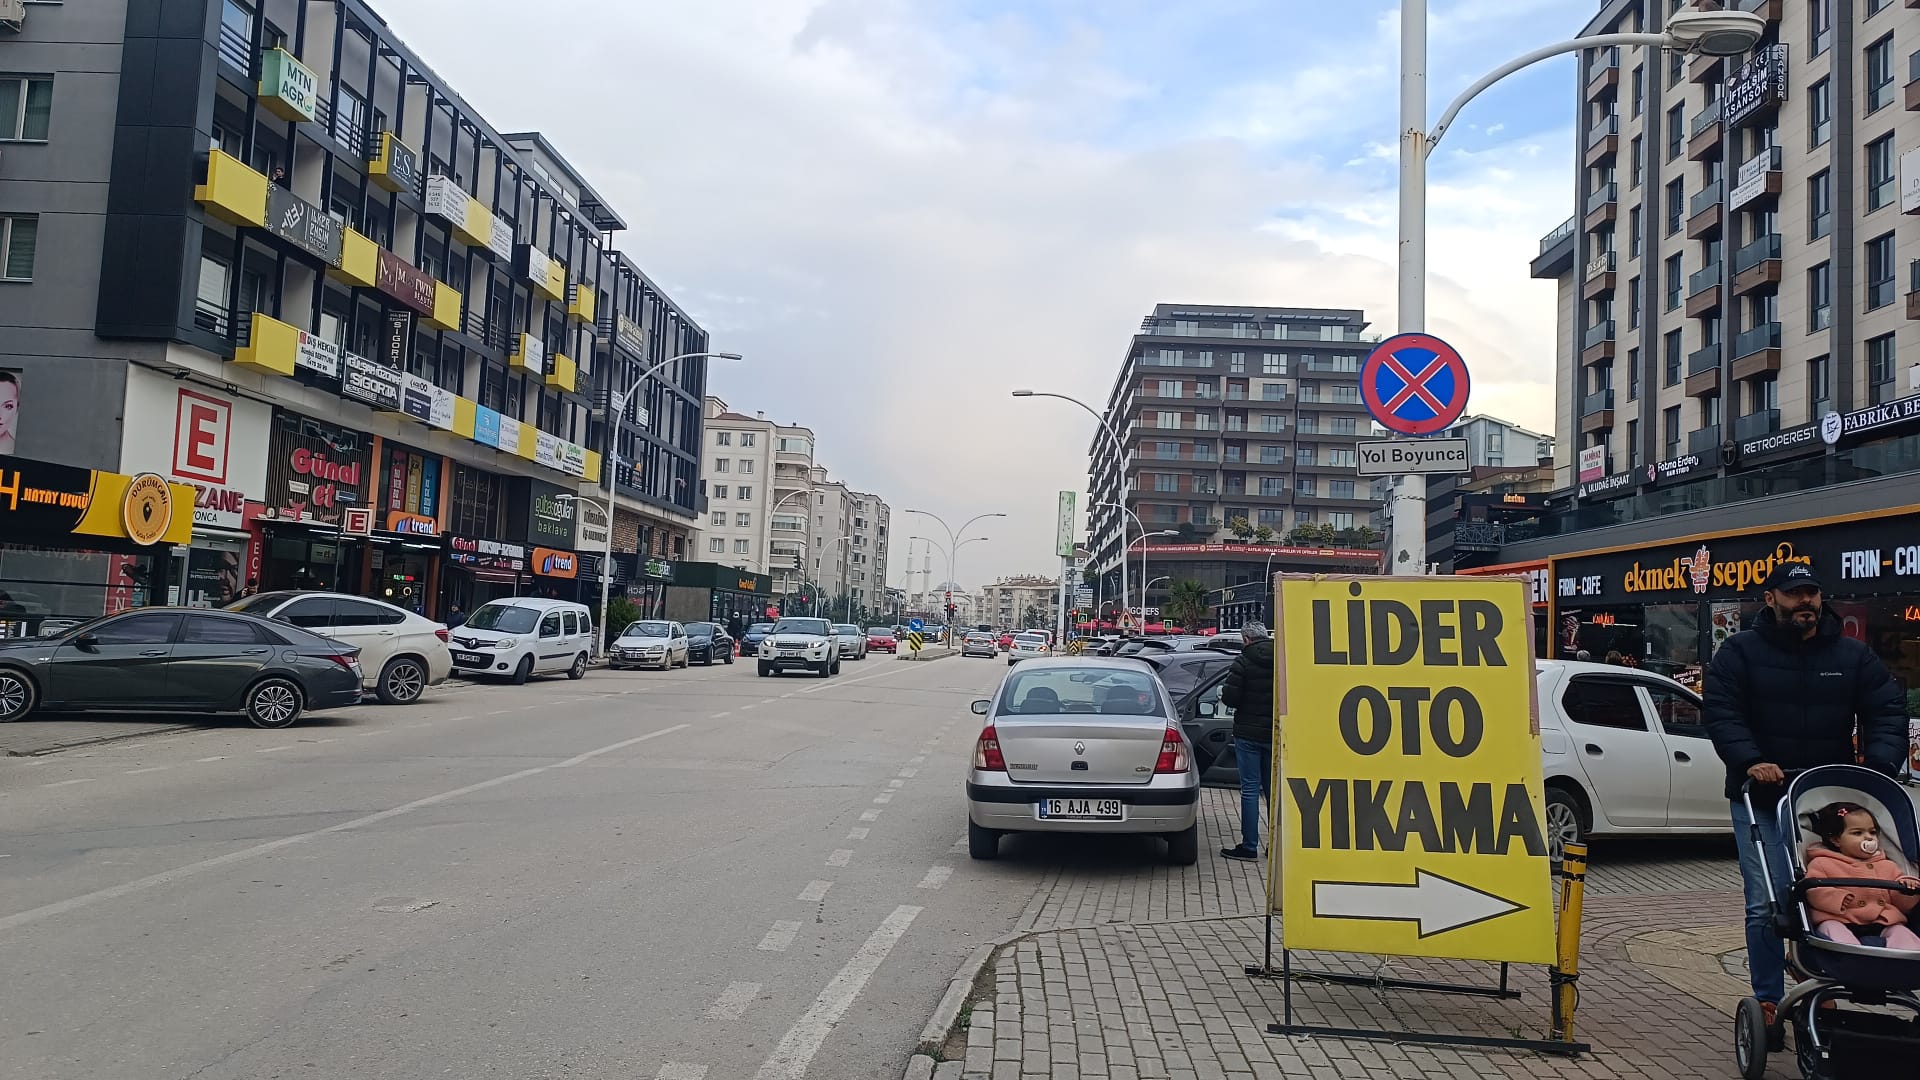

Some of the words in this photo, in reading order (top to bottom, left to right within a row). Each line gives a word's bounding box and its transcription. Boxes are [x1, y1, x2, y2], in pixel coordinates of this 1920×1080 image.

[286, 61, 312, 92] MTN
[349, 372, 397, 400] SİGORTA
[1843, 404, 1900, 431] FABRİKA
[187, 403, 218, 470] E
[1743, 426, 1817, 455] RETROPEREST
[290, 447, 360, 486] Günal
[1362, 449, 1386, 463] Yol
[1392, 448, 1465, 465] Boyunca
[312, 484, 335, 508] et
[411, 518, 434, 535] trend
[554, 556, 573, 571] trend
[1624, 556, 1687, 592] ekmek
[1841, 549, 1880, 579] FIRIN
[1558, 577, 1576, 597] FIRIN
[1581, 575, 1601, 595] CAFE
[1312, 581, 1508, 667] LİDER
[1339, 685, 1484, 758] OTO
[1048, 799, 1061, 814] 16
[1067, 800, 1090, 815] AJA
[1096, 800, 1119, 815] 499
[1286, 777, 1548, 857] YIKAMA
